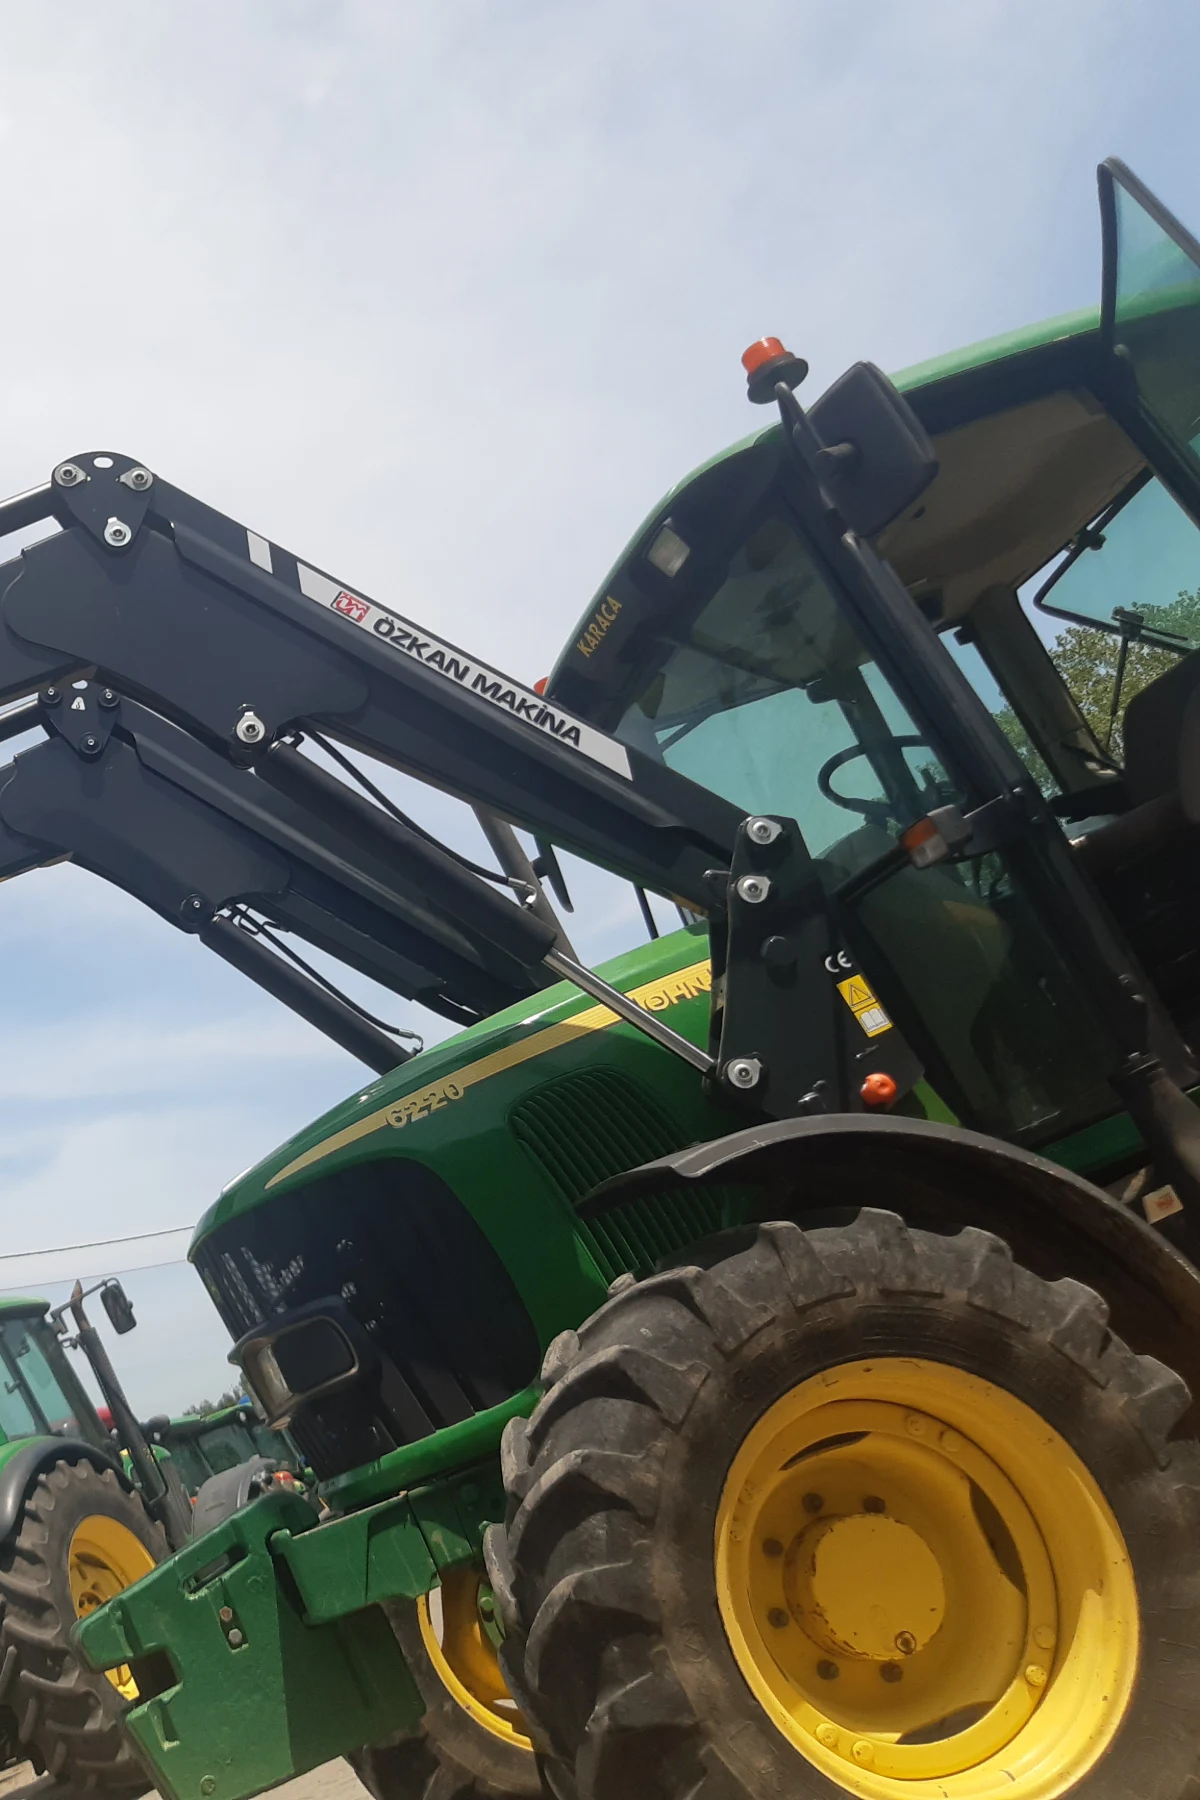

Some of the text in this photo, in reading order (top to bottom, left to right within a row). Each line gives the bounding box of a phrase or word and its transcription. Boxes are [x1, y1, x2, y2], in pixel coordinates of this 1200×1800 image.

[576, 595, 623, 658] KARACA
[373, 617, 582, 747] ÖZKAN MAKİNA
[824, 949, 852, 973] CE
[385, 1083, 464, 1129] 6220
